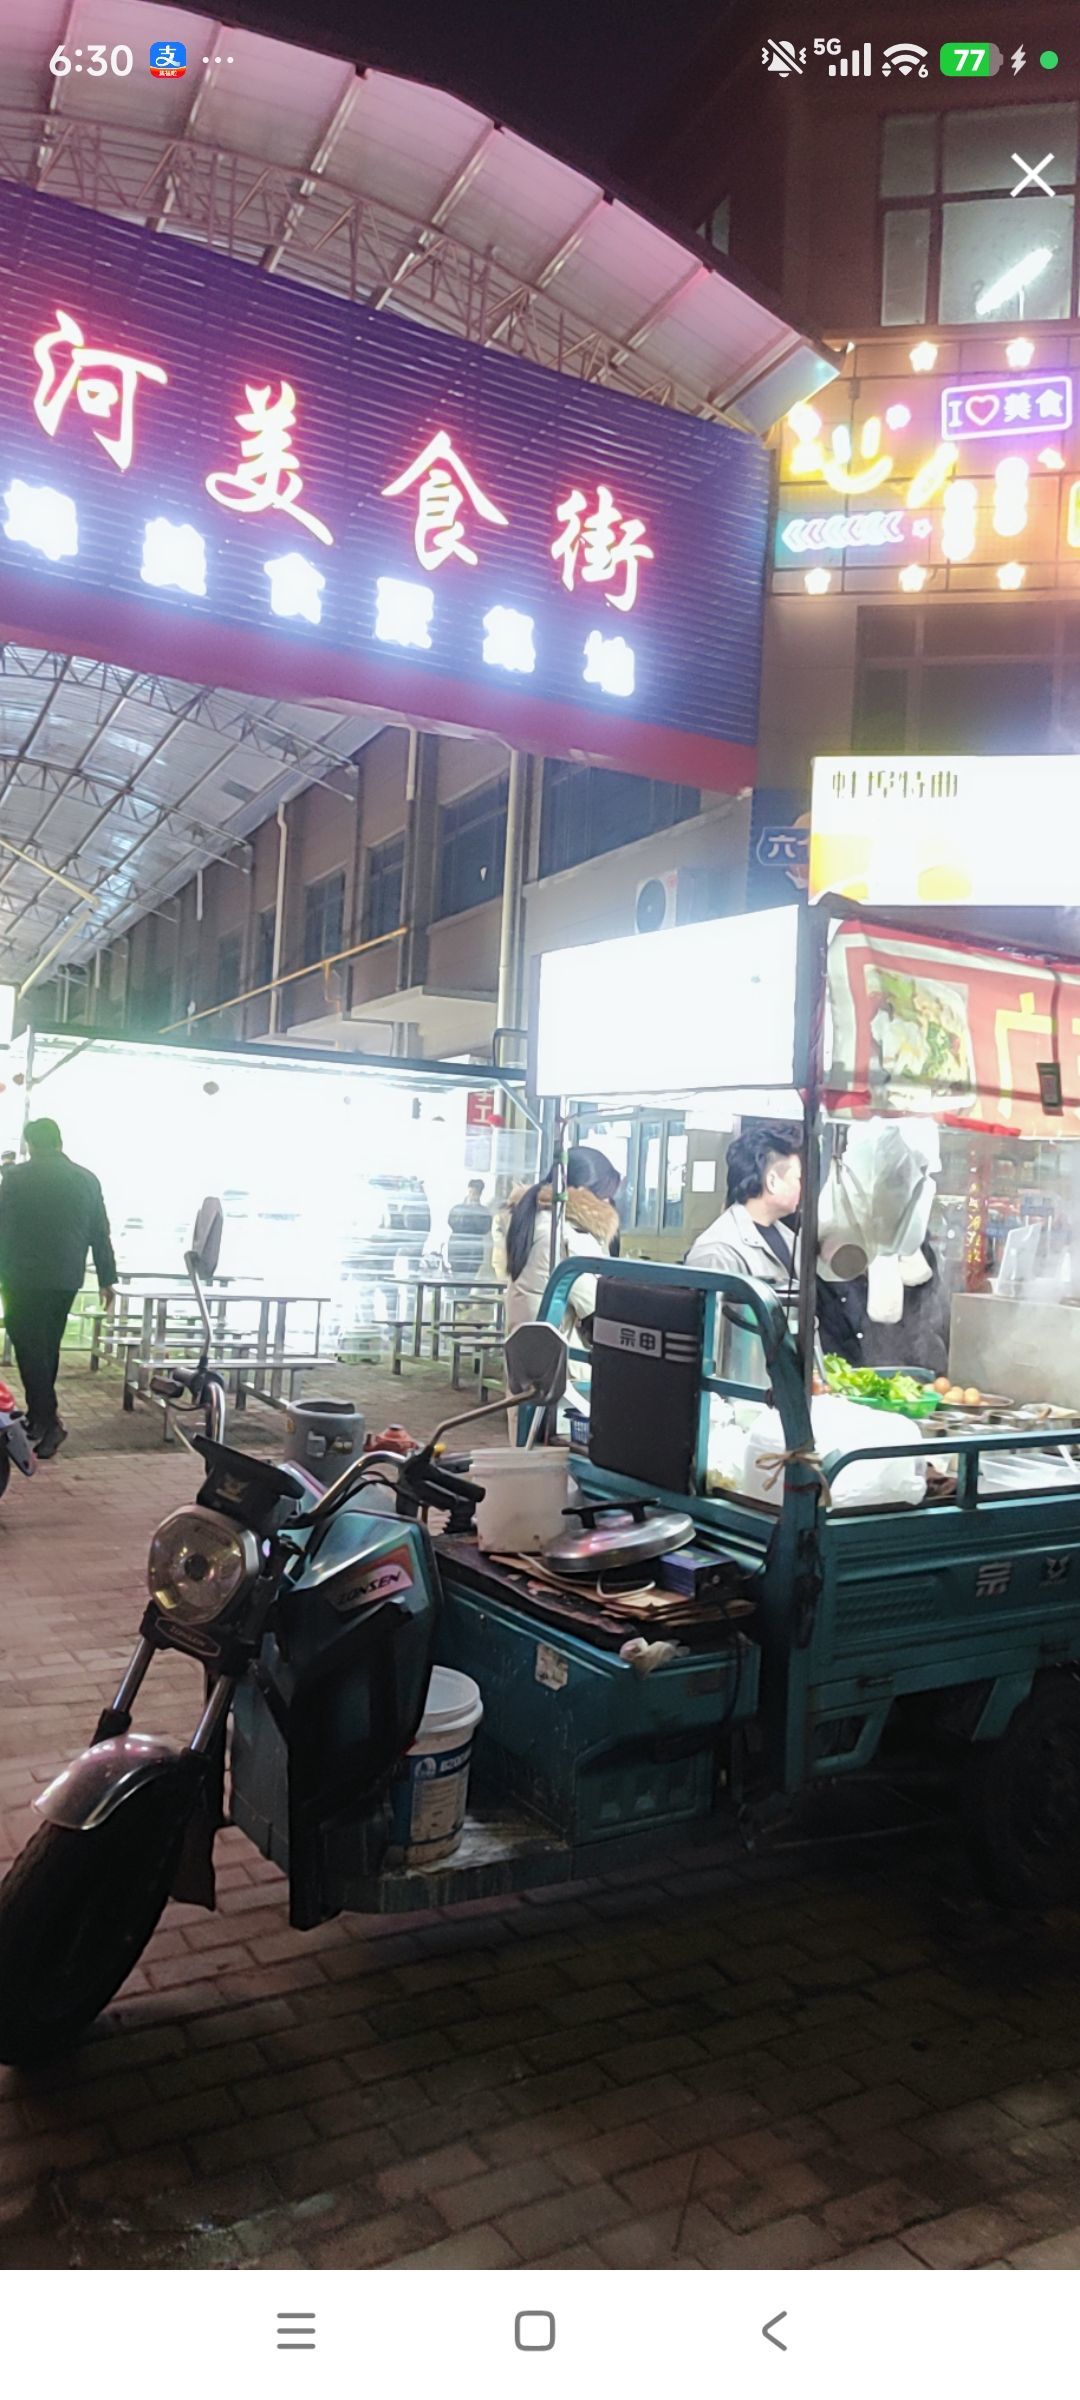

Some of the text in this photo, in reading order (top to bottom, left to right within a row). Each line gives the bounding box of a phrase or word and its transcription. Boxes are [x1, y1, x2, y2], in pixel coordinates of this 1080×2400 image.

[33, 309, 655, 611] 河美食街
[768, 834, 809, 858] 六
